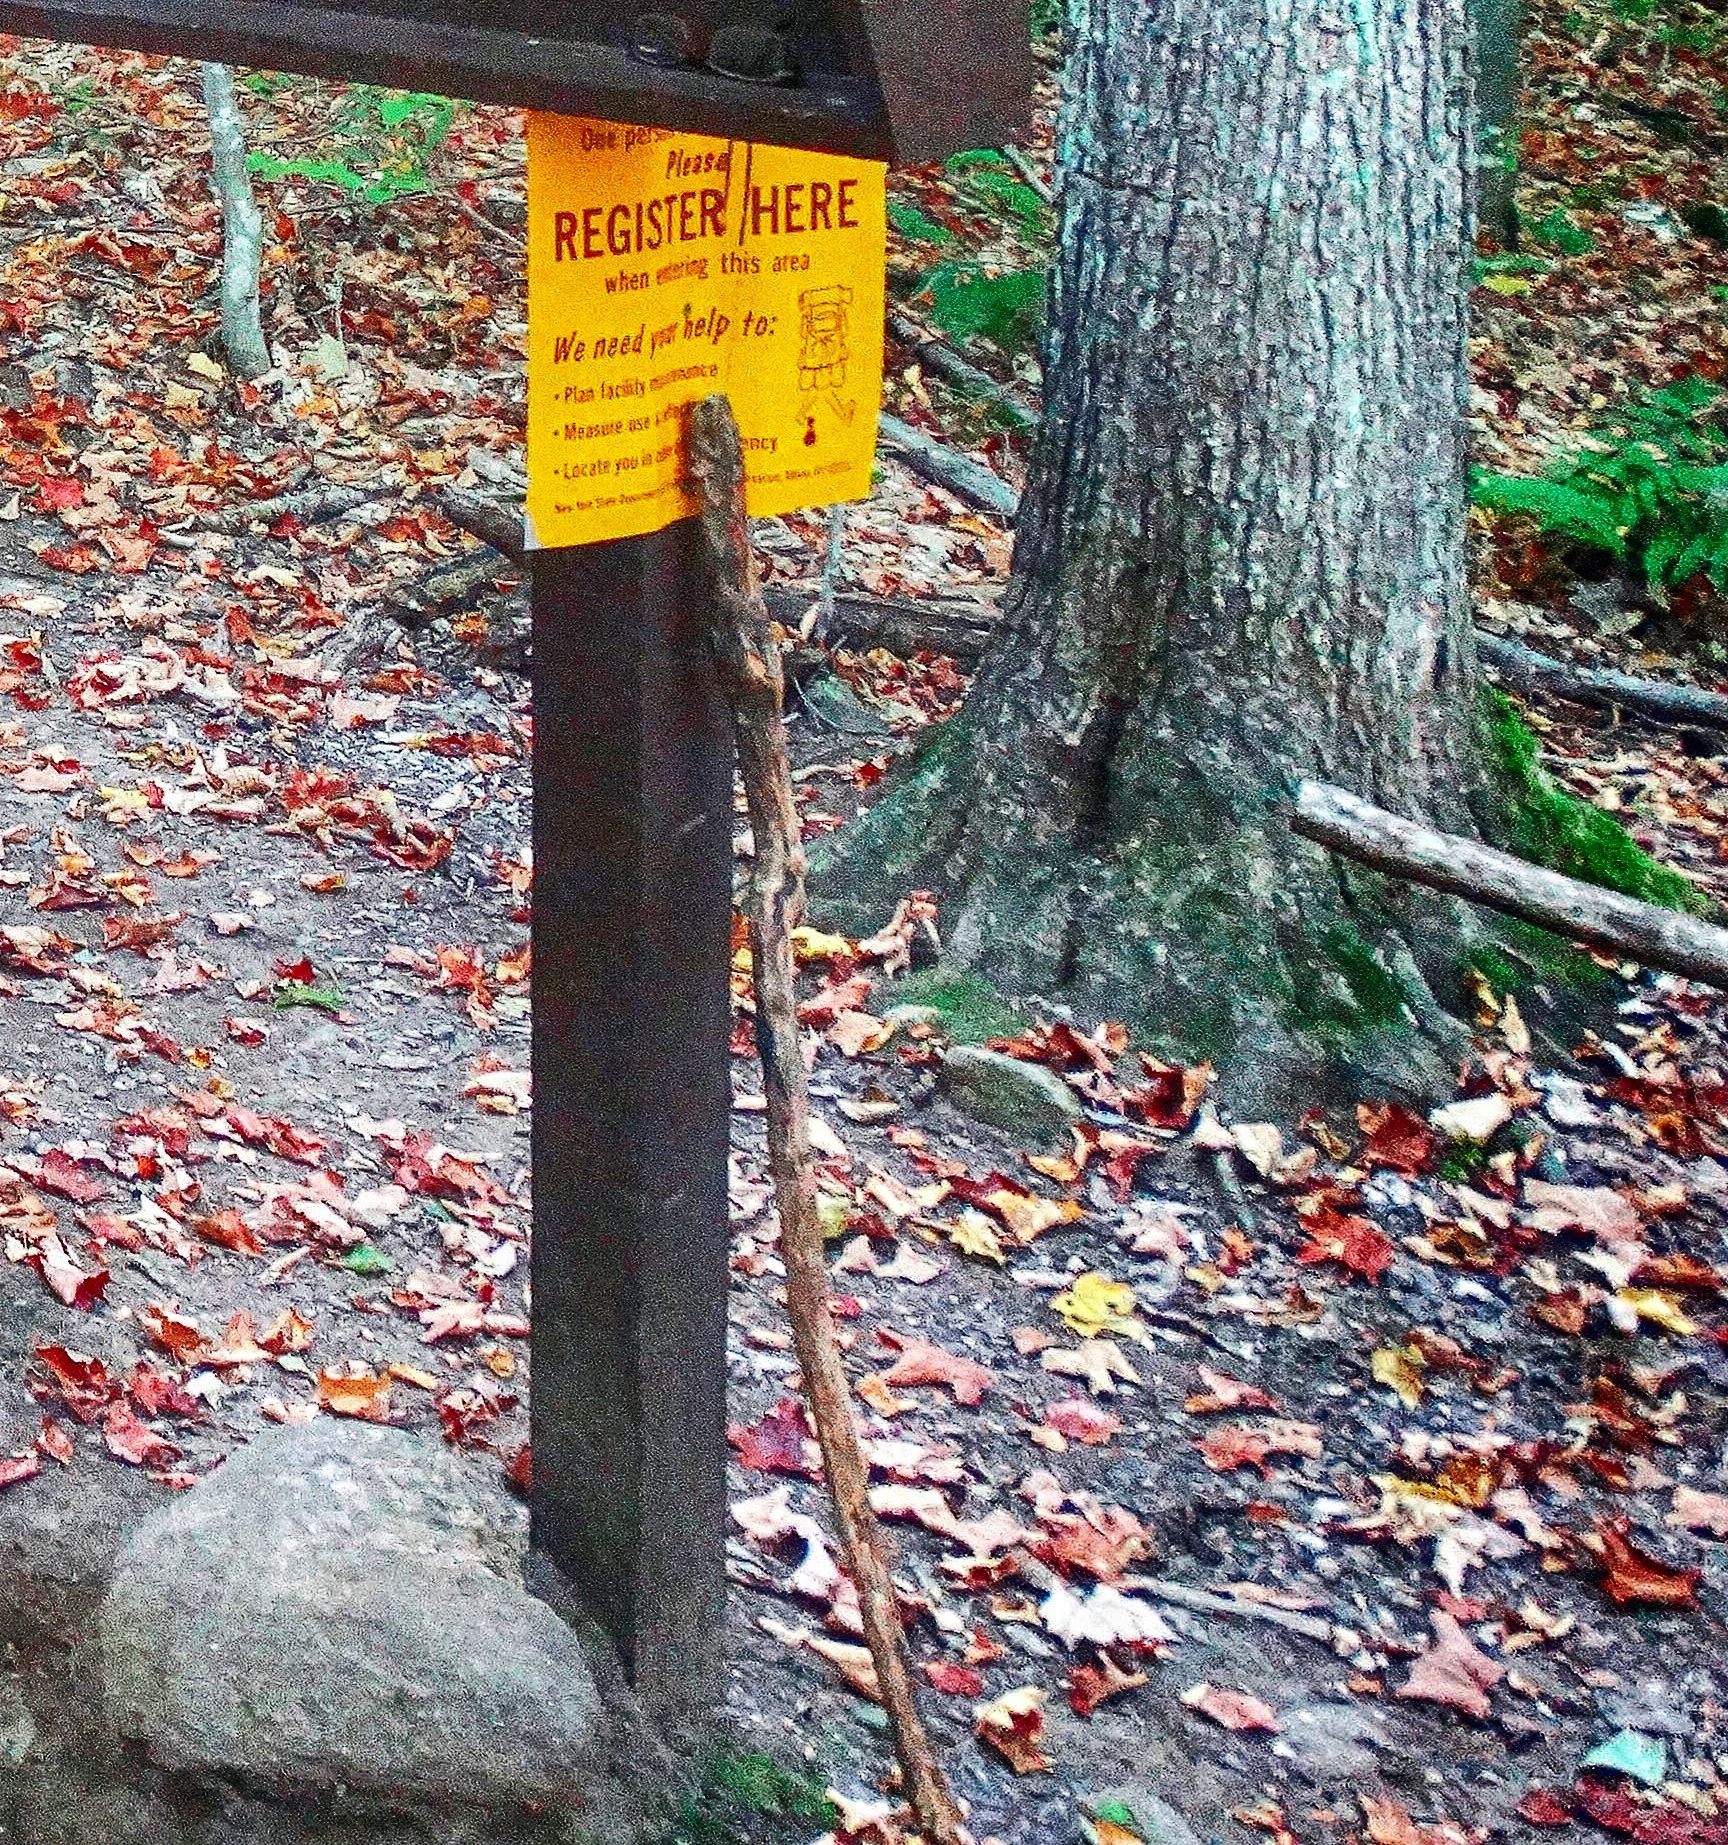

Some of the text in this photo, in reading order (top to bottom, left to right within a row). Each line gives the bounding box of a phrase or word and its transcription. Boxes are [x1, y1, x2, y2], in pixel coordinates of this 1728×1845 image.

[666, 148, 731, 180] Please
[554, 178, 859, 263] REGISTER HERE
[604, 269, 651, 294] when
[720, 252, 762, 276] this
[772, 253, 812, 272] area
[553, 330, 587, 365] We
[593, 323, 647, 360] need
[682, 305, 732, 346] help
[743, 309, 778, 338] to:
[563, 384, 596, 404] Plan
[563, 416, 651, 441] Measure use
[563, 460, 611, 481] Locate
[614, 456, 640, 476] you
